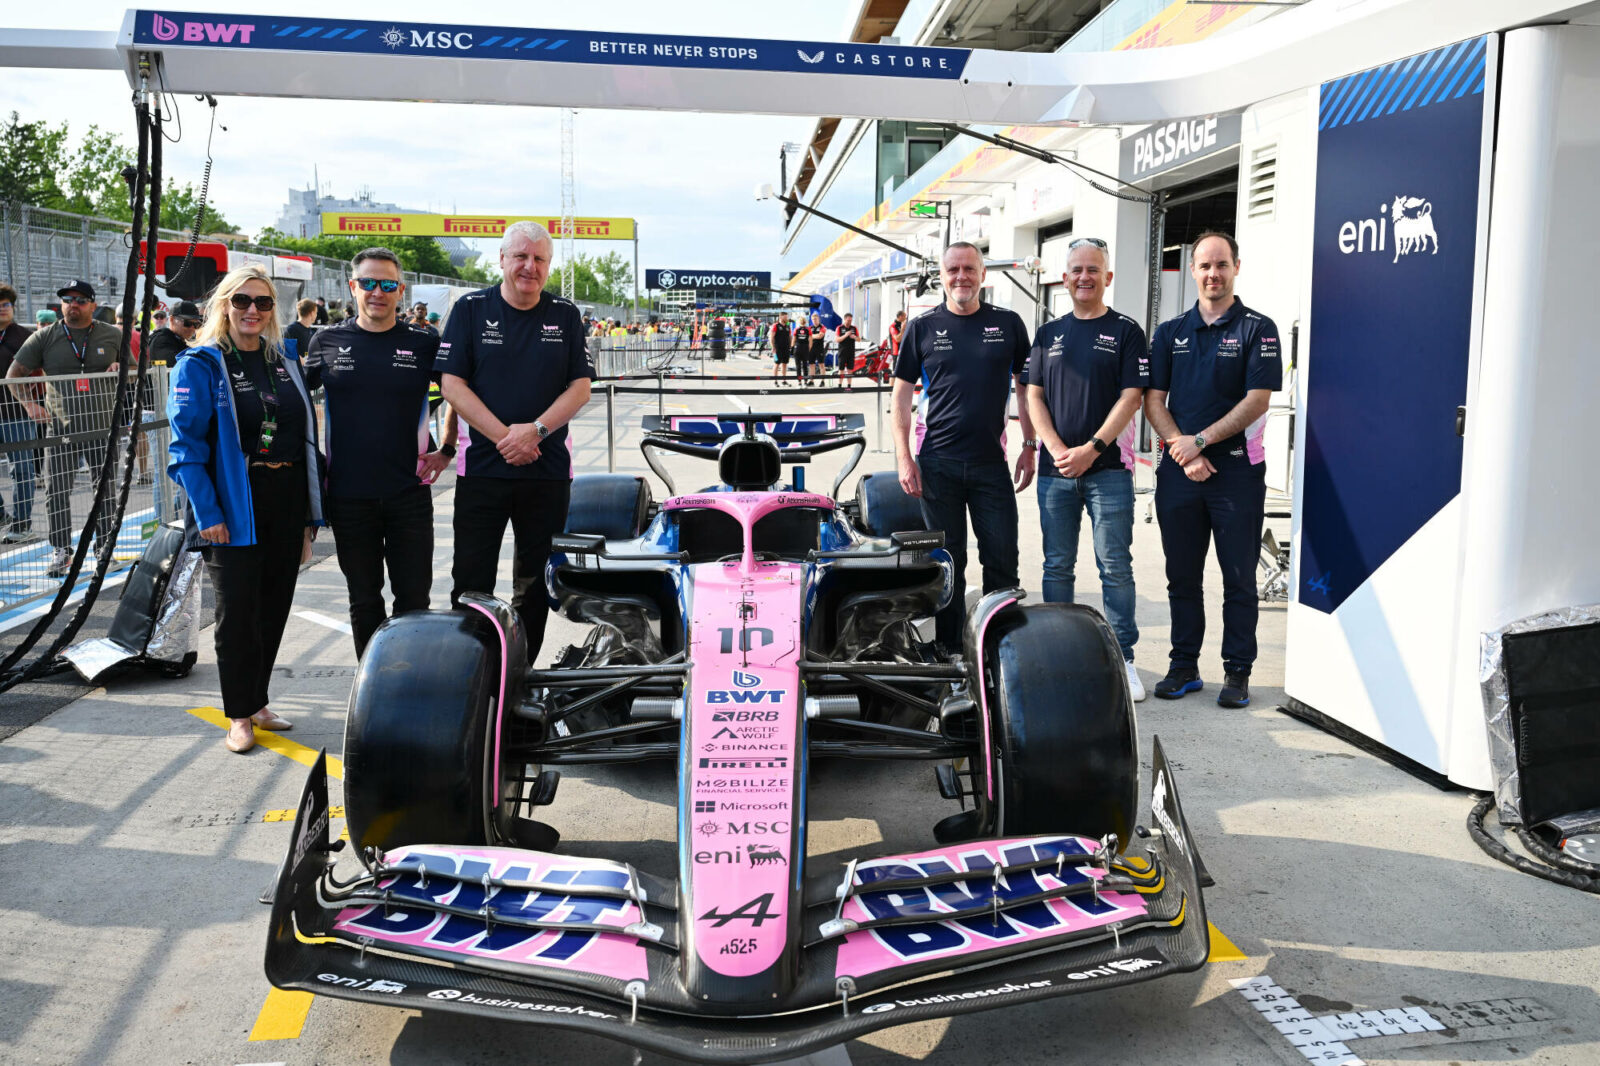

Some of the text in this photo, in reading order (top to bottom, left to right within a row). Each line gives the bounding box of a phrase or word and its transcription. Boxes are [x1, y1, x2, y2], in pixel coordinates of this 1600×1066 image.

[183, 22, 255, 44] BWT
[410, 30, 473, 50] MSC
[590, 40, 757, 60] BETTER NEVER STOPS
[836, 52, 948, 69] CASTORE
[1133, 117, 1217, 175] PASSAGE
[339, 216, 402, 231] PIRELLI
[444, 218, 506, 233] PIRELLI
[1338, 203, 1388, 253] eni
[680, 274, 759, 288] crypto.com
[717, 627, 774, 654] 10
[706, 690, 786, 704] BWT
[736, 711, 779, 722] BRB
[721, 743, 788, 751] BINANCE
[699, 757, 788, 768] PIRELLI
[720, 801, 789, 811] Microsoft
[727, 821, 789, 835] MSC
[694, 846, 741, 864] eni
[1067, 965, 1118, 980] eni
[317, 973, 373, 988] eni
[896, 978, 1053, 1008] businessolver
[459, 993, 618, 1021] businessolver
